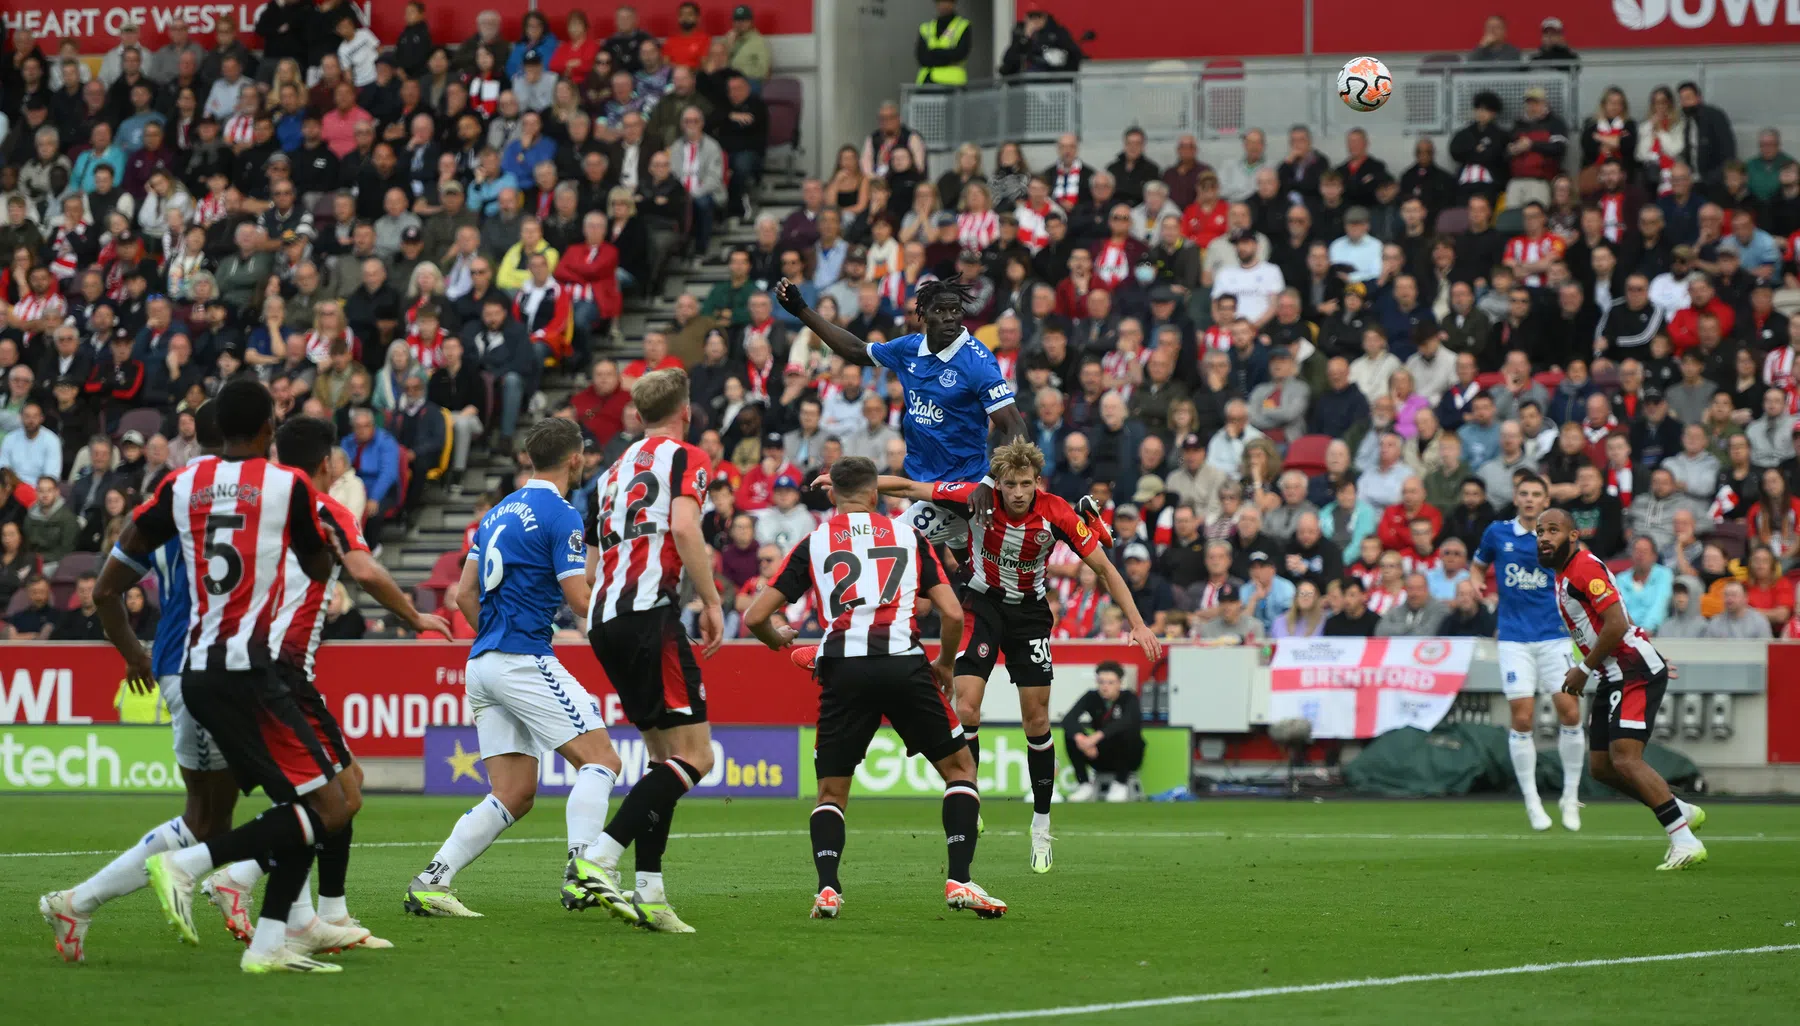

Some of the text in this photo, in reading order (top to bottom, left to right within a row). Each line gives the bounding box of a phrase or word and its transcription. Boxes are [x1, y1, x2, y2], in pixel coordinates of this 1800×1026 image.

[3, 8, 101, 38] HEART
[104, 6, 147, 37] OF
[908, 389, 944, 423] Stake
[483, 501, 539, 532] TARKOWSKI
[599, 470, 660, 553] 22
[913, 506, 936, 530] 8
[833, 523, 890, 544] JANELT
[201, 514, 247, 596] 5
[483, 524, 507, 592] 6
[980, 546, 1038, 569] HOLLYWOOD
[823, 546, 909, 619] 27
[1505, 562, 1548, 589] Stake
[1029, 637, 1052, 664] 30
[1301, 667, 1436, 690] BRENTFORD
[320, 692, 475, 739] ONDO
[1609, 690, 1622, 714] 9
[726, 757, 783, 787] bets
